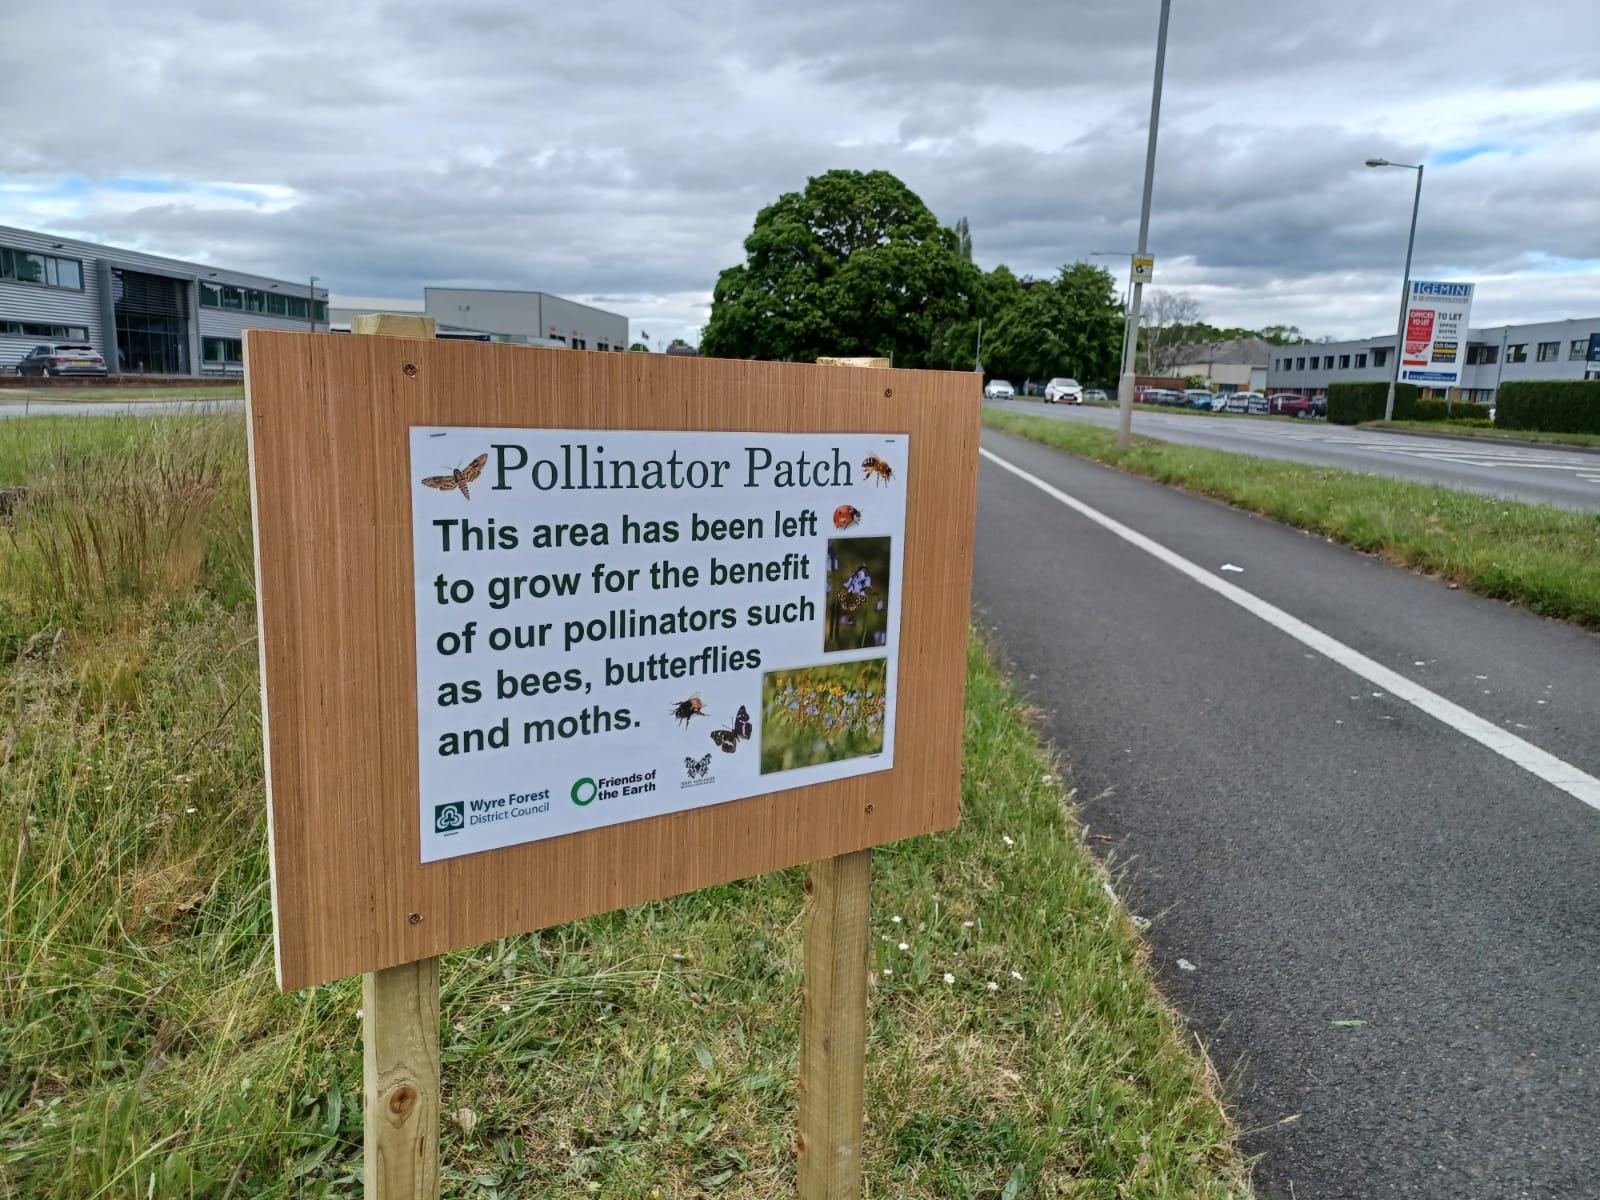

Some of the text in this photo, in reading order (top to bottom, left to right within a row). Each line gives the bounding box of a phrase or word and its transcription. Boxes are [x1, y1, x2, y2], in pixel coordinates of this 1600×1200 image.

[1421, 283, 1470, 297] GEMINI
[1438, 312, 1463, 321] TO LET
[490, 444, 854, 490] Pollinator Patch
[432, 509, 818, 553] This area has been left
[433, 553, 810, 610] to grow for the benefit
[436, 595, 816, 656] of our pollinators such
[437, 645, 762, 708] as bees, butterflies
[438, 704, 642, 758] and moths.
[598, 769, 657, 789] Friends of
[598, 781, 656, 801] the Earth
[470, 788, 550, 813] Wyre Forest
[470, 801, 550, 826] District Council
